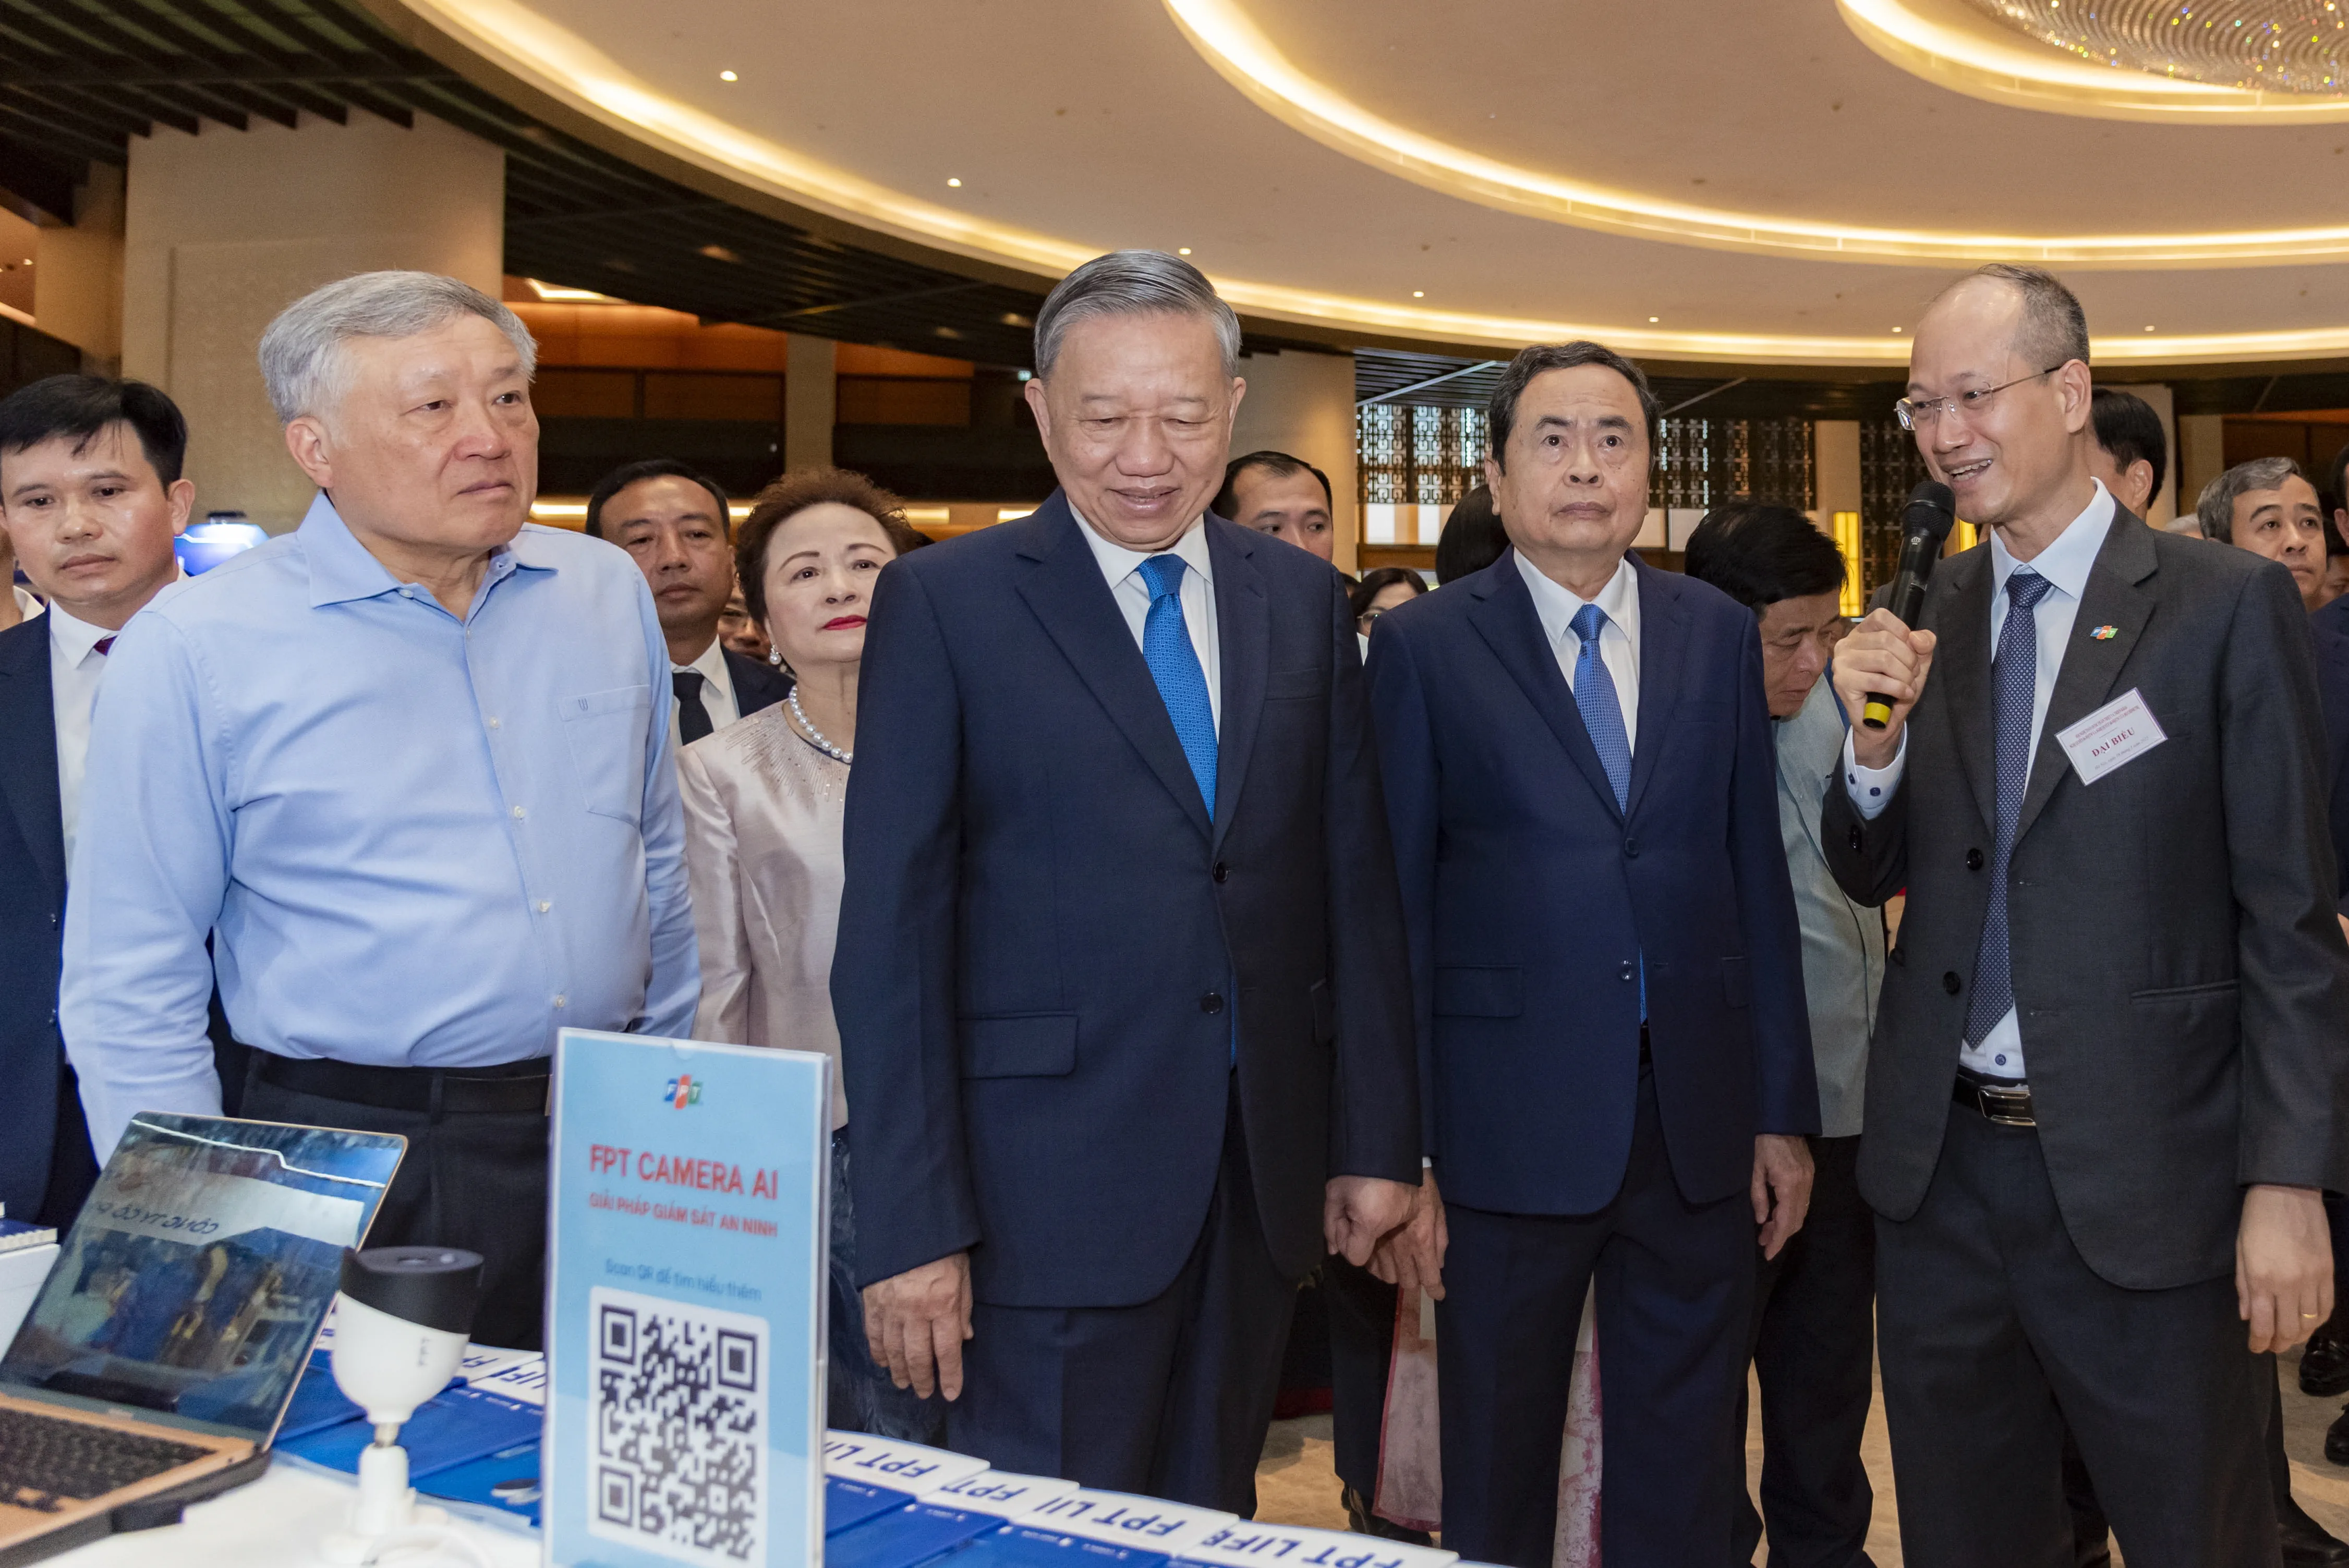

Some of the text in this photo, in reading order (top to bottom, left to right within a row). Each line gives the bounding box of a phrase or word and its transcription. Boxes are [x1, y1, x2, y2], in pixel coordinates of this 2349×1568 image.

[590, 1144, 778, 1199] FPT CAMERA AI
[617, 1196, 650, 1215] PHÁP
[653, 1201, 687, 1223] GIÁM
[692, 1206, 716, 1226] SÁT
[720, 1214, 739, 1231] AN
[743, 1218, 778, 1237] NINH
[855, 1453, 941, 1478] FPT
[940, 1479, 1030, 1501] FPT
[1092, 1508, 1187, 1536] FPT
[1201, 1528, 1303, 1558] LIFE
